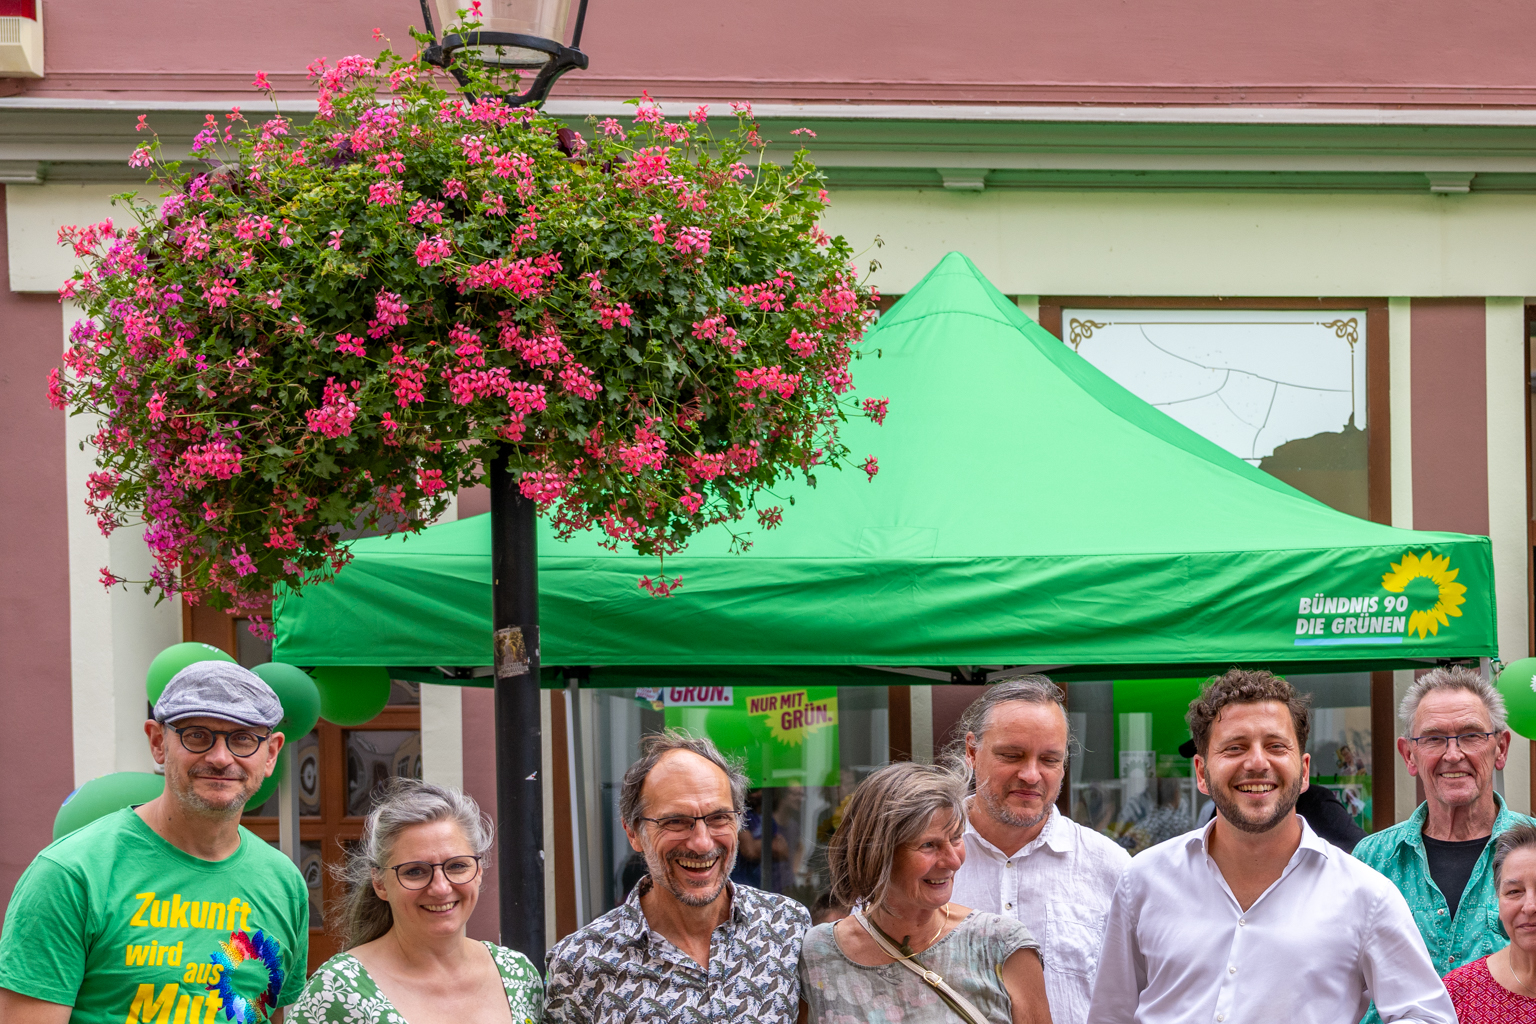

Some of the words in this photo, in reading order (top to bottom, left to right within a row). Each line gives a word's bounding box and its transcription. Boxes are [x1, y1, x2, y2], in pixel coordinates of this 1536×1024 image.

[1298, 593, 1379, 614] BÜNDNIS
[1384, 596, 1409, 613] 90
[1295, 618, 1325, 635] DIE
[1331, 613, 1406, 634] GRÜNEN
[750, 696, 778, 714] NUR
[779, 692, 805, 709] MIT
[781, 703, 833, 731] GRÜN.
[129, 891, 252, 932] Zukunft
[125, 940, 184, 967] wird
[183, 962, 224, 985] aus
